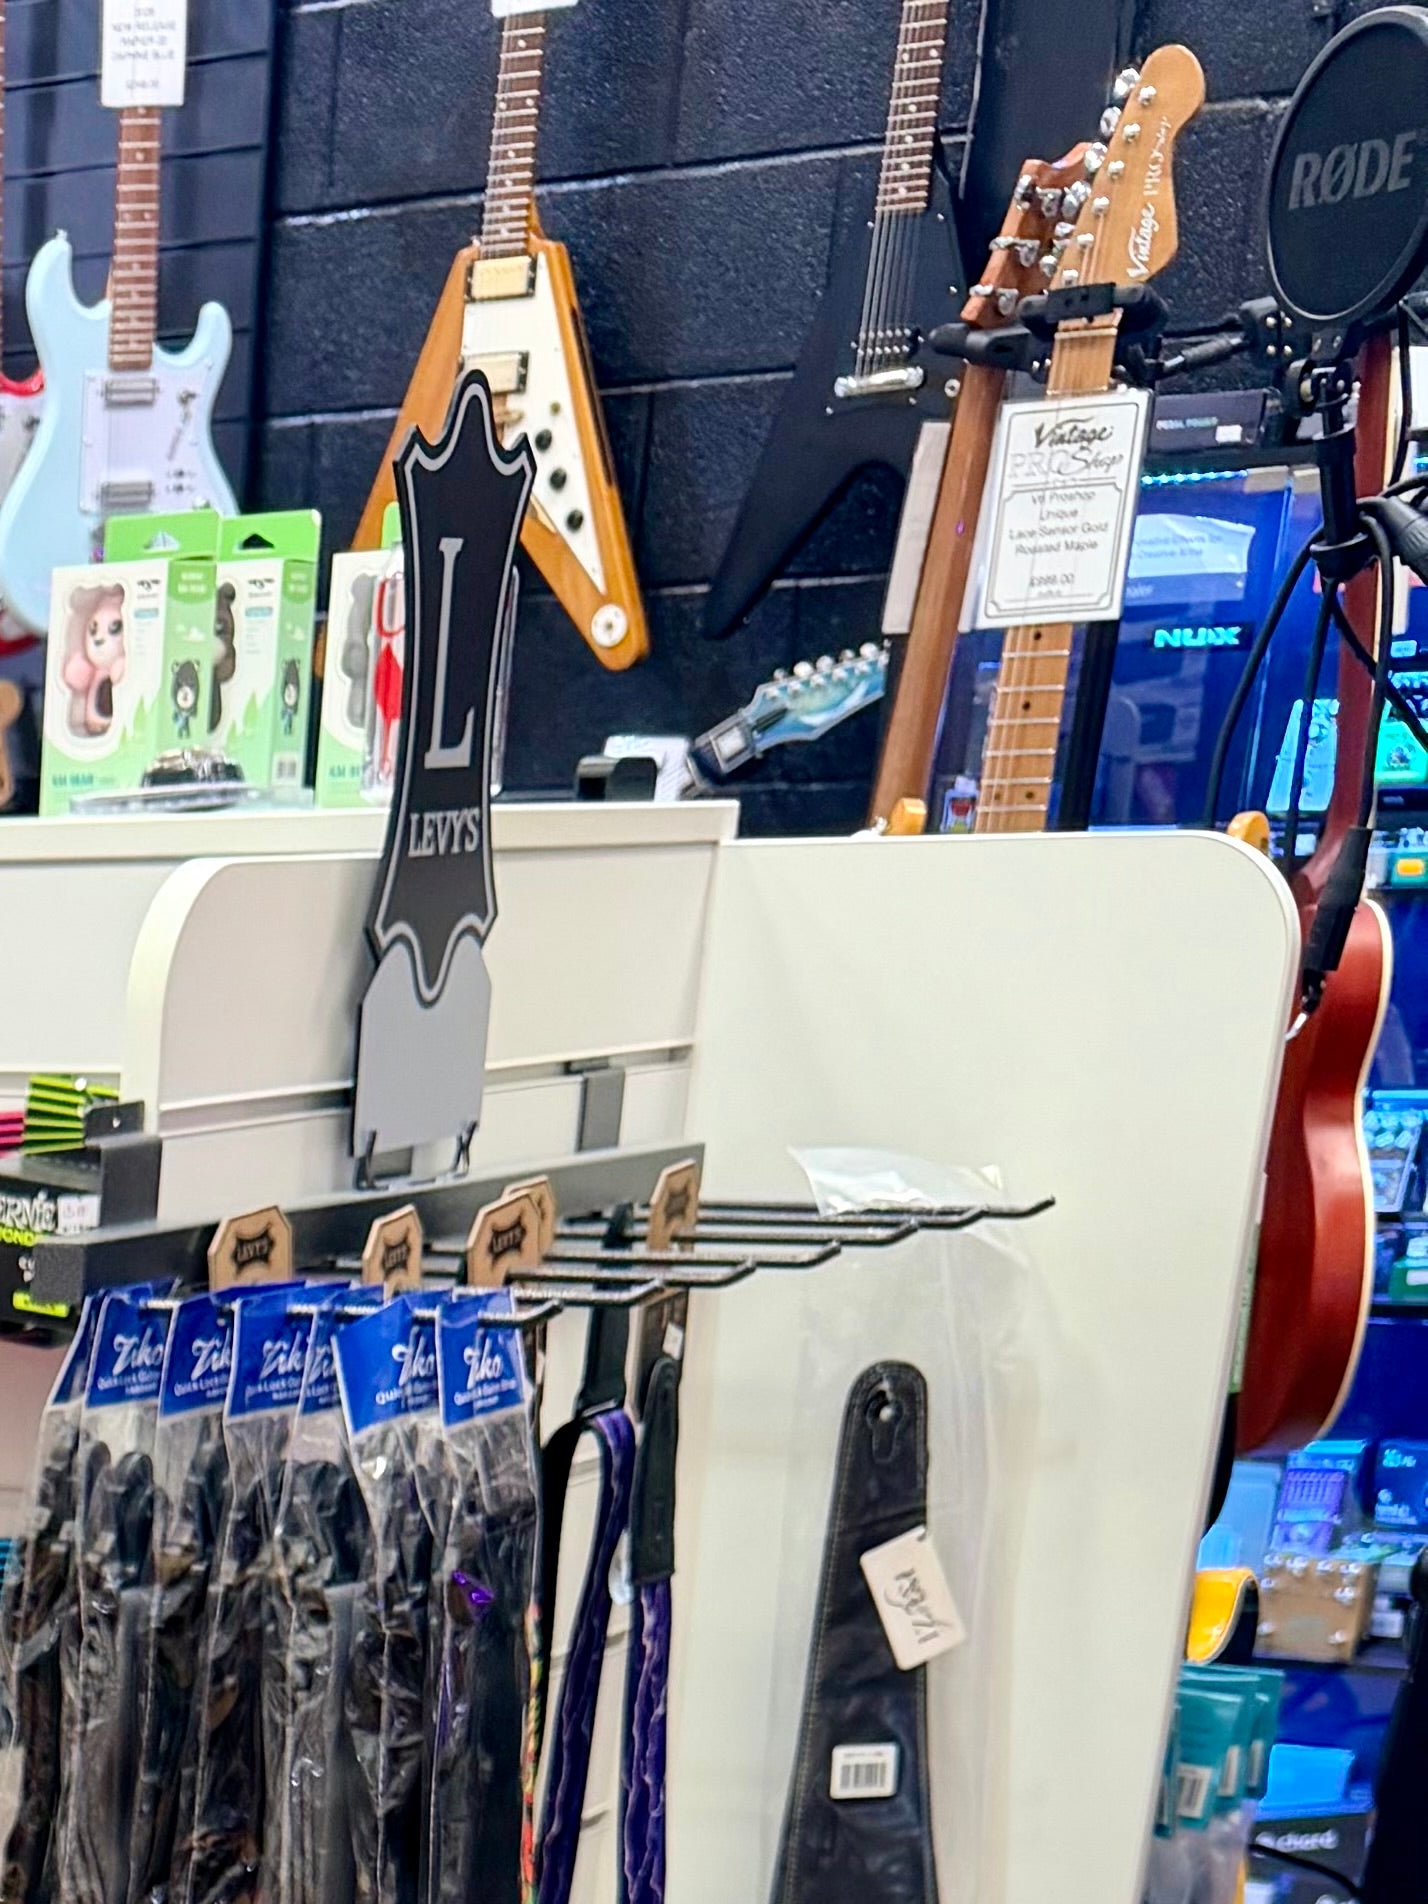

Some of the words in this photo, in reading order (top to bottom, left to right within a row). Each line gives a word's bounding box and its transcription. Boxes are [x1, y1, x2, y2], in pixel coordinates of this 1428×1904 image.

[1288, 131, 1417, 211] RØDE
[1126, 202, 1160, 278] Vintage
[1034, 416, 1114, 451] Vintage
